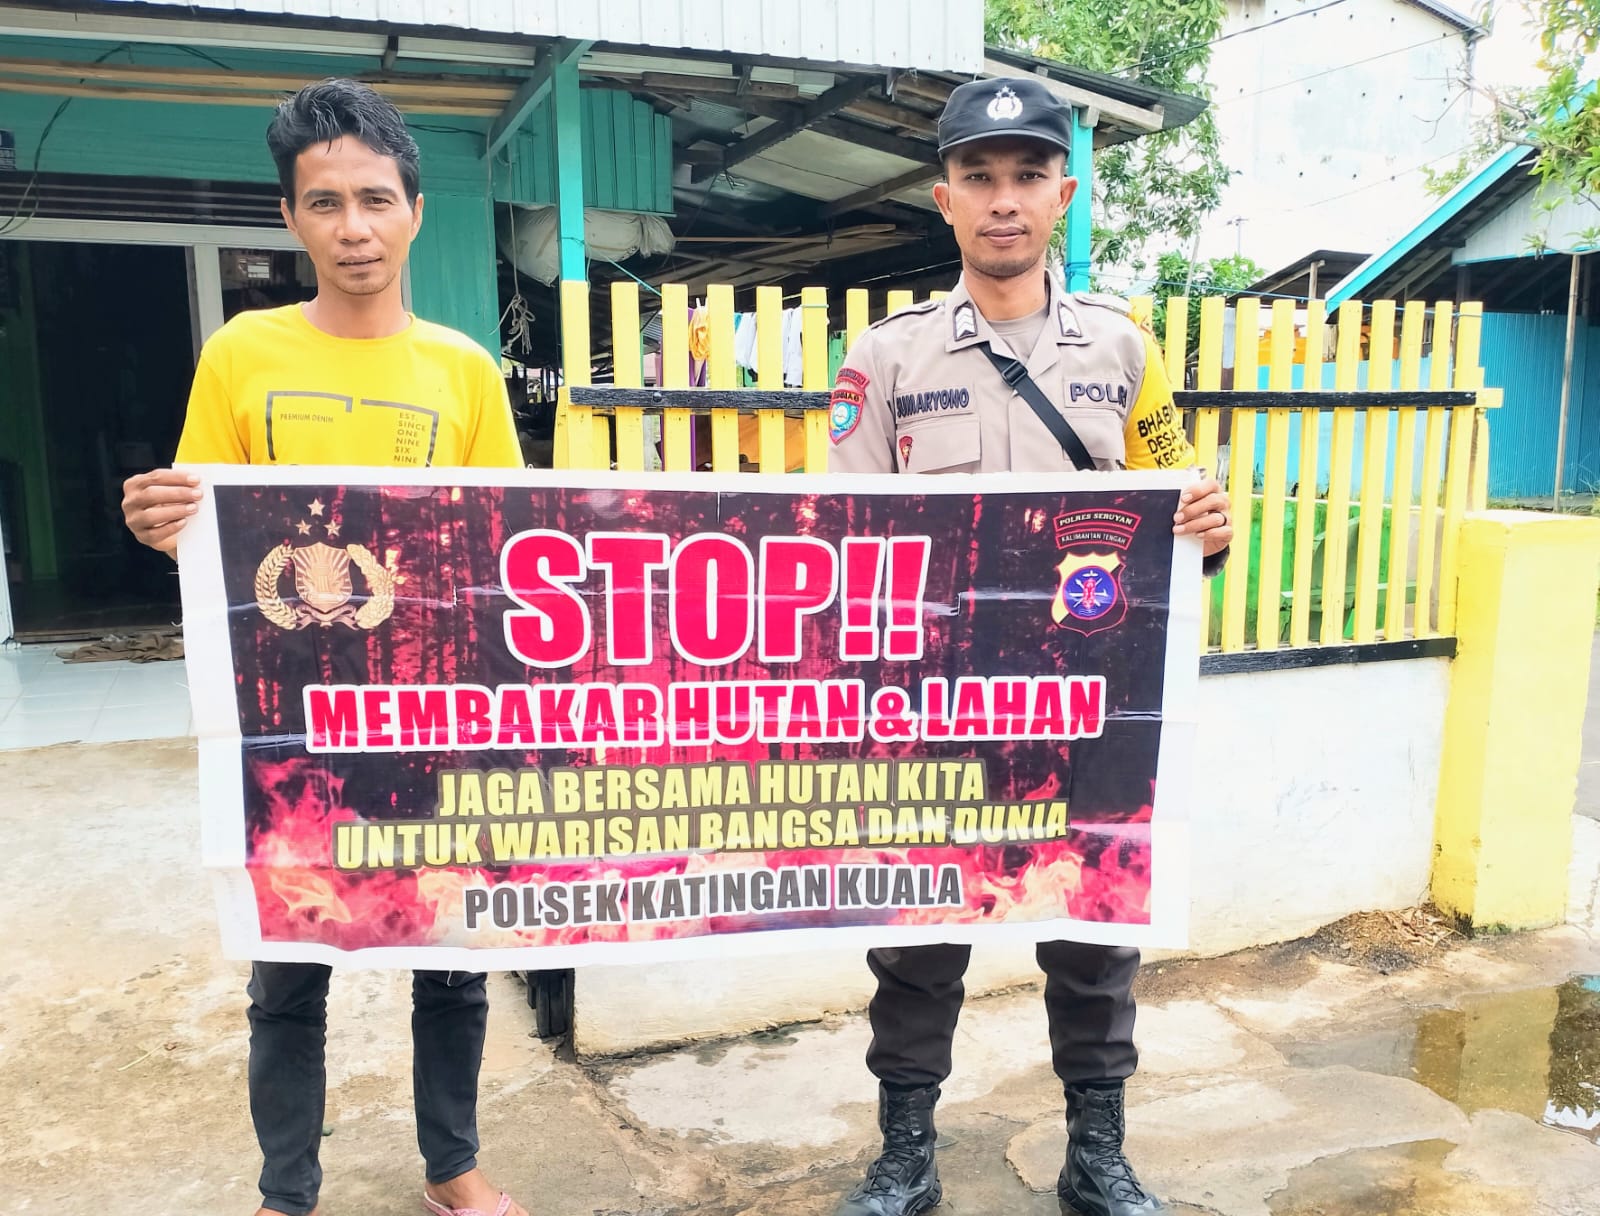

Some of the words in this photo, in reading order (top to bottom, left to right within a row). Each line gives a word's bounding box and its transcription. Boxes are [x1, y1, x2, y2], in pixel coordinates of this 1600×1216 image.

[280, 412, 310, 421] PREMIUM
[311, 414, 334, 423] DENIM
[398, 419, 427, 432] SINCE
[397, 428, 418, 438] ONE
[396, 437, 421, 448] NINE
[1147, 428, 1179, 455] DESA
[394, 446, 411, 454] SIX
[393, 454, 418, 464] NINE
[1059, 513, 1092, 526] POLRES
[1093, 512, 1133, 526] SERUYAN
[1061, 532, 1102, 543] KALIMANTAN
[1102, 534, 1127, 545] TENGAH
[501, 530, 931, 667] STOP!!
[305, 685, 662, 751] MEMBAKAR
[671, 682, 863, 744] HUTAN
[872, 689, 917, 740] &
[923, 678, 1104, 740] LAHAN
[437, 771, 547, 817] JAGA
[551, 766, 752, 813] BERSAMA
[758, 762, 890, 805] HUTAN
[896, 761, 986, 802] KITA
[336, 822, 484, 870] UNTUK
[489, 813, 691, 863] WARISAN
[699, 807, 861, 850] BANGSA
[866, 806, 948, 846] DAN
[950, 801, 1070, 846] DUNIA
[464, 881, 626, 931] POLSEK
[631, 867, 828, 922] KATINGAN
[837, 866, 963, 907] KUALA
